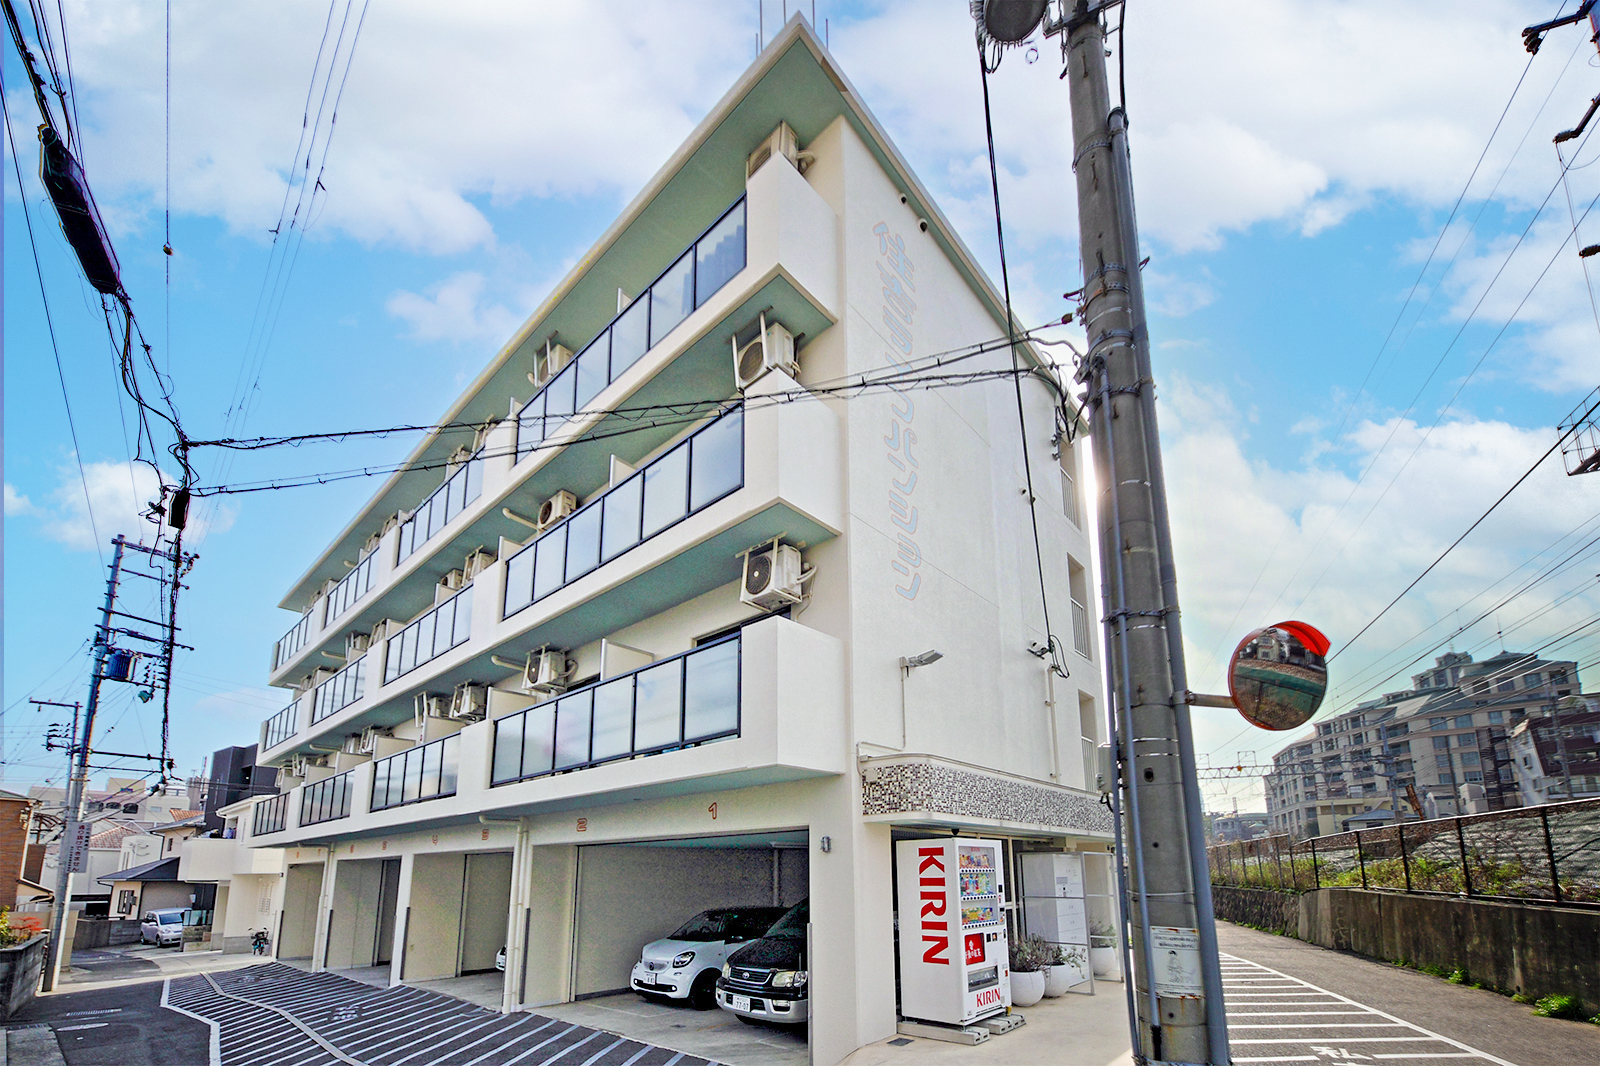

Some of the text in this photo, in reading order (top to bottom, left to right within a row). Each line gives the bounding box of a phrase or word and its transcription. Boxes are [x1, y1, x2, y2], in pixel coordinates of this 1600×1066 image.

[708, 802, 717, 820] 1
[576, 818, 587, 832] 2
[918, 847, 950, 965] KIRIN
[976, 988, 1001, 1008] KIRIN
